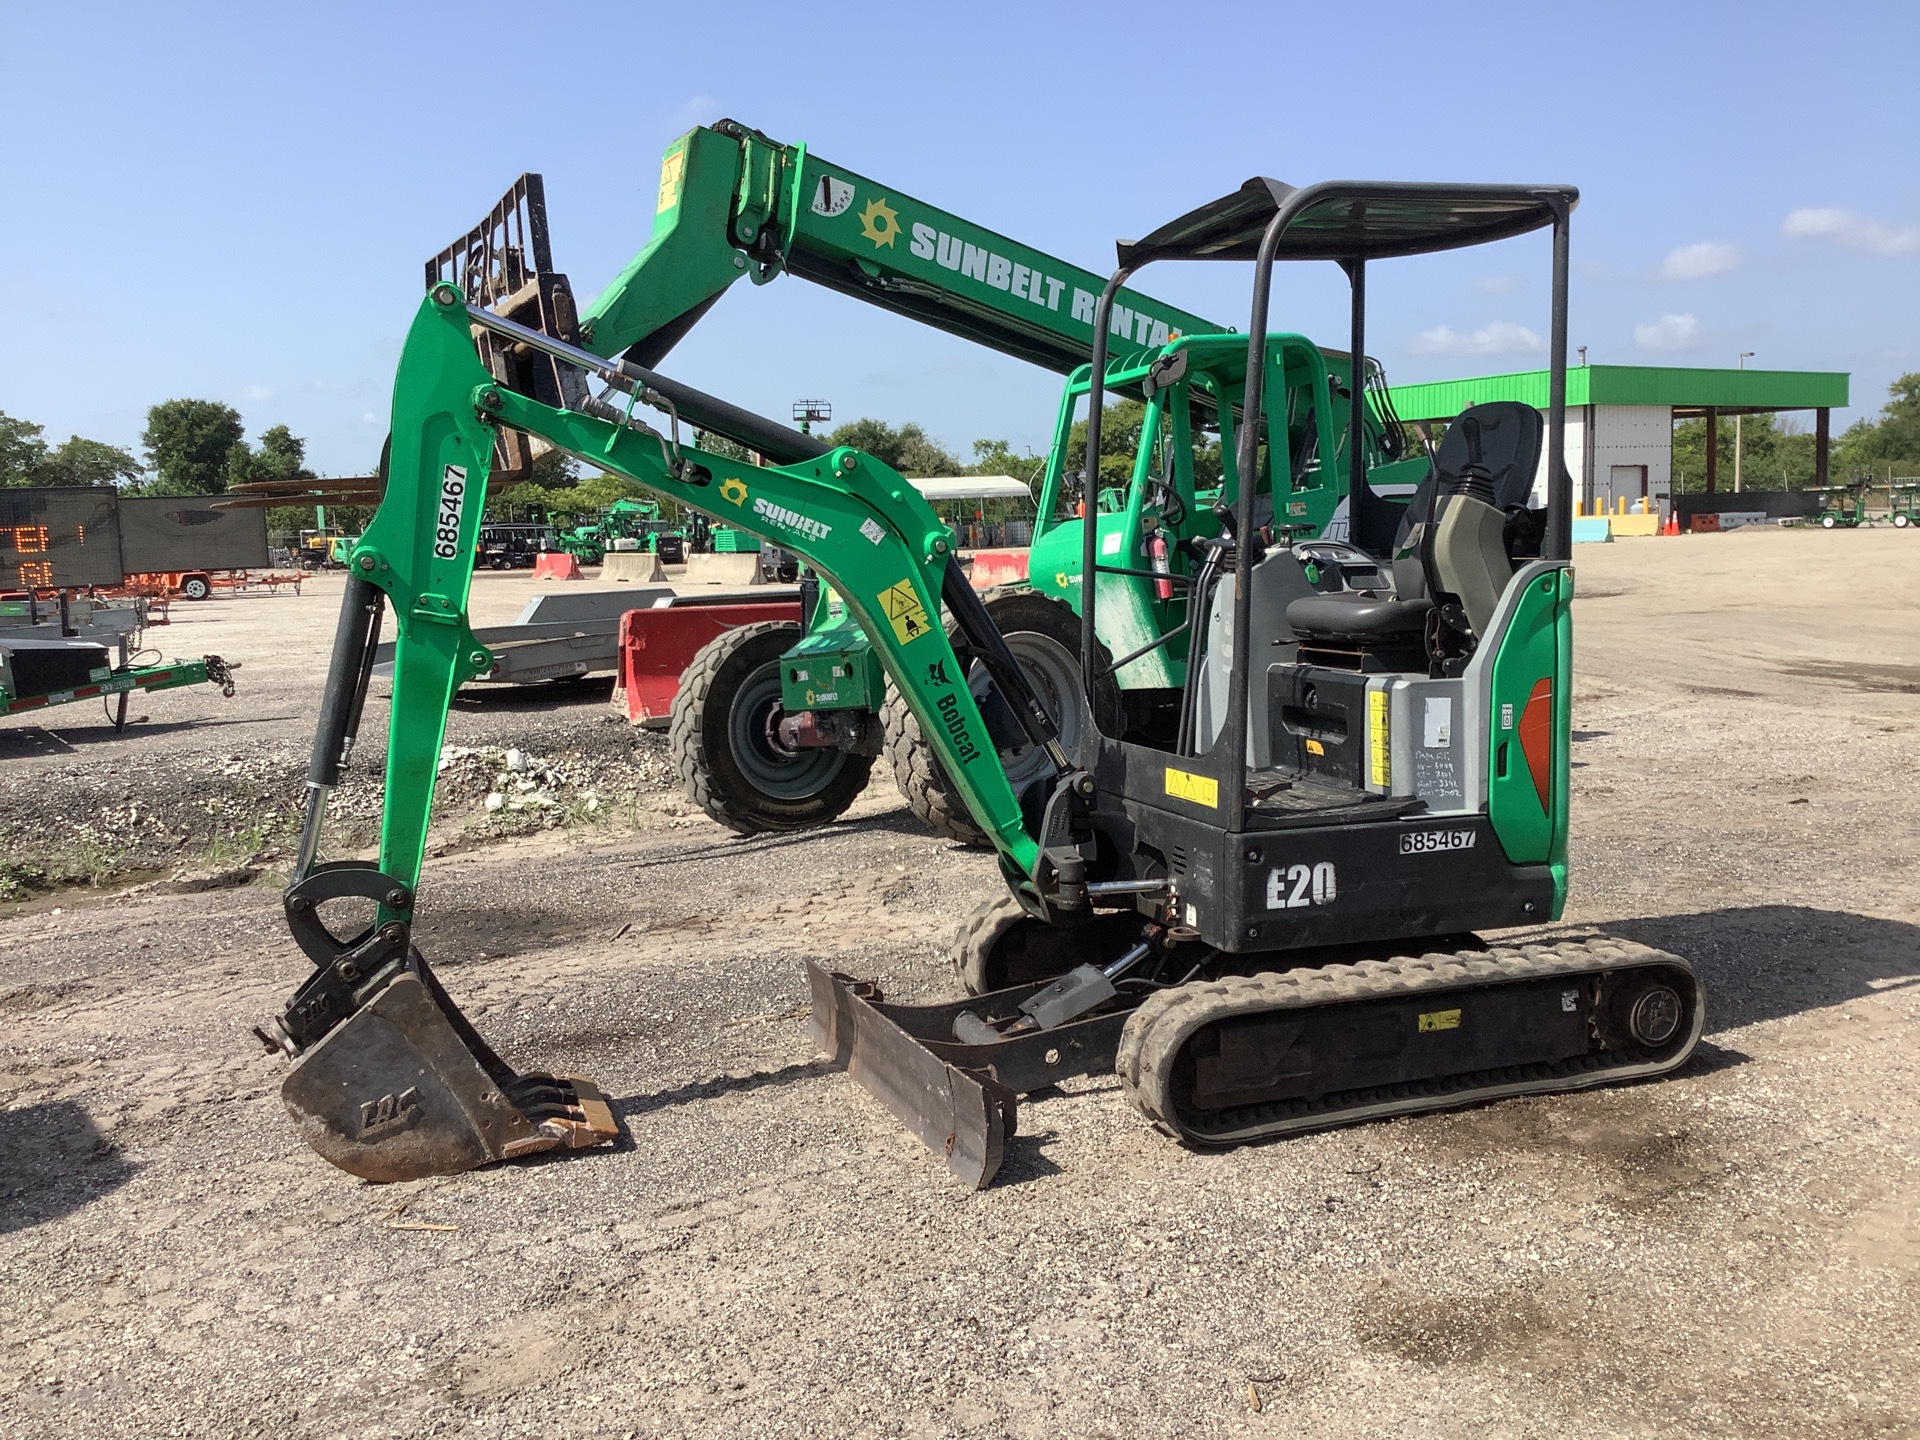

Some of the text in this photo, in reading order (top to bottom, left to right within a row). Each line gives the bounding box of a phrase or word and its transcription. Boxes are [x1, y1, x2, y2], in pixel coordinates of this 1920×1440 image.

[909, 221, 1066, 313] SUNBELT
[434, 464, 466, 559] 685467
[752, 497, 833, 540] SUNBELT
[760, 515, 817, 542] RENALS
[936, 692, 982, 765] Bobcat
[1401, 829, 1475, 853] 685467
[1266, 860, 1337, 910] E20
